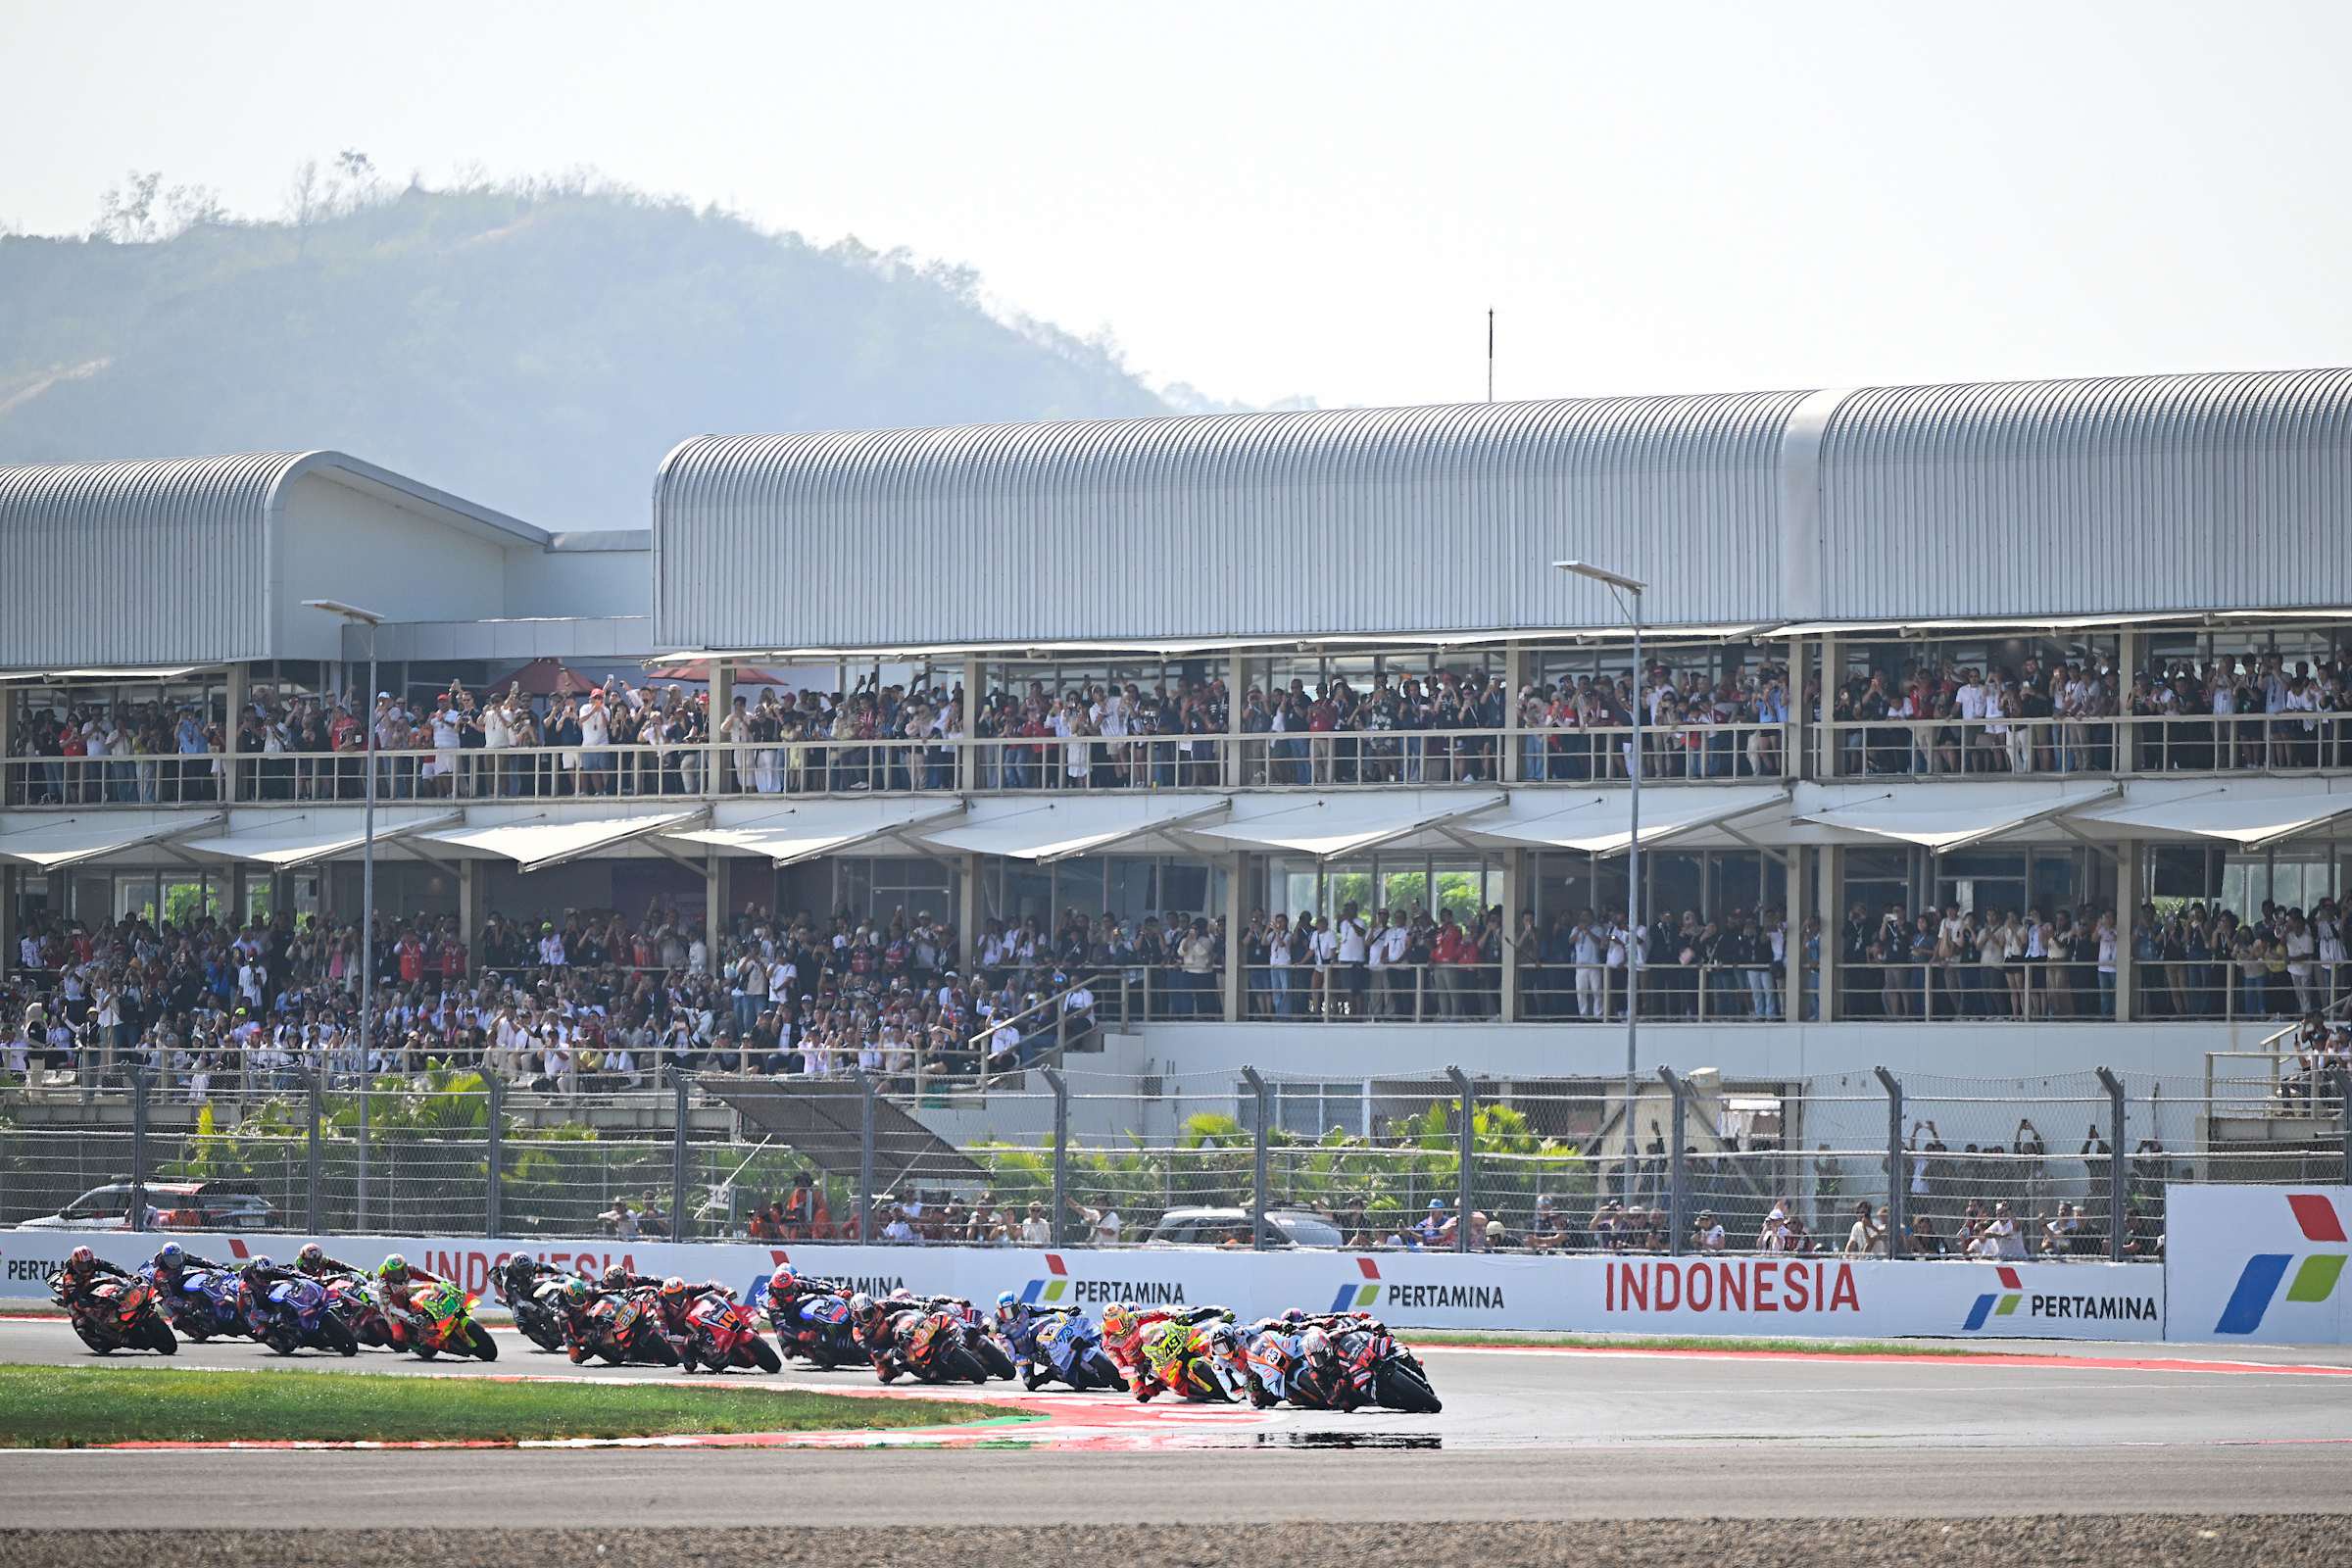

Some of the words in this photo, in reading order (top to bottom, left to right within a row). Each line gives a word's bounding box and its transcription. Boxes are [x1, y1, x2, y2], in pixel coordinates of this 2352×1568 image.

[425, 1250, 636, 1298] INDOSA
[800, 1276, 906, 1298] TAMINA
[1075, 1281, 1184, 1304] PERTAMINA
[1389, 1285, 1504, 1308] PERTAMINA
[1606, 1262, 1860, 1312] INDONESIA
[719, 1310, 738, 1328] 10
[2032, 1295, 2157, 1320] PERTAMINA
